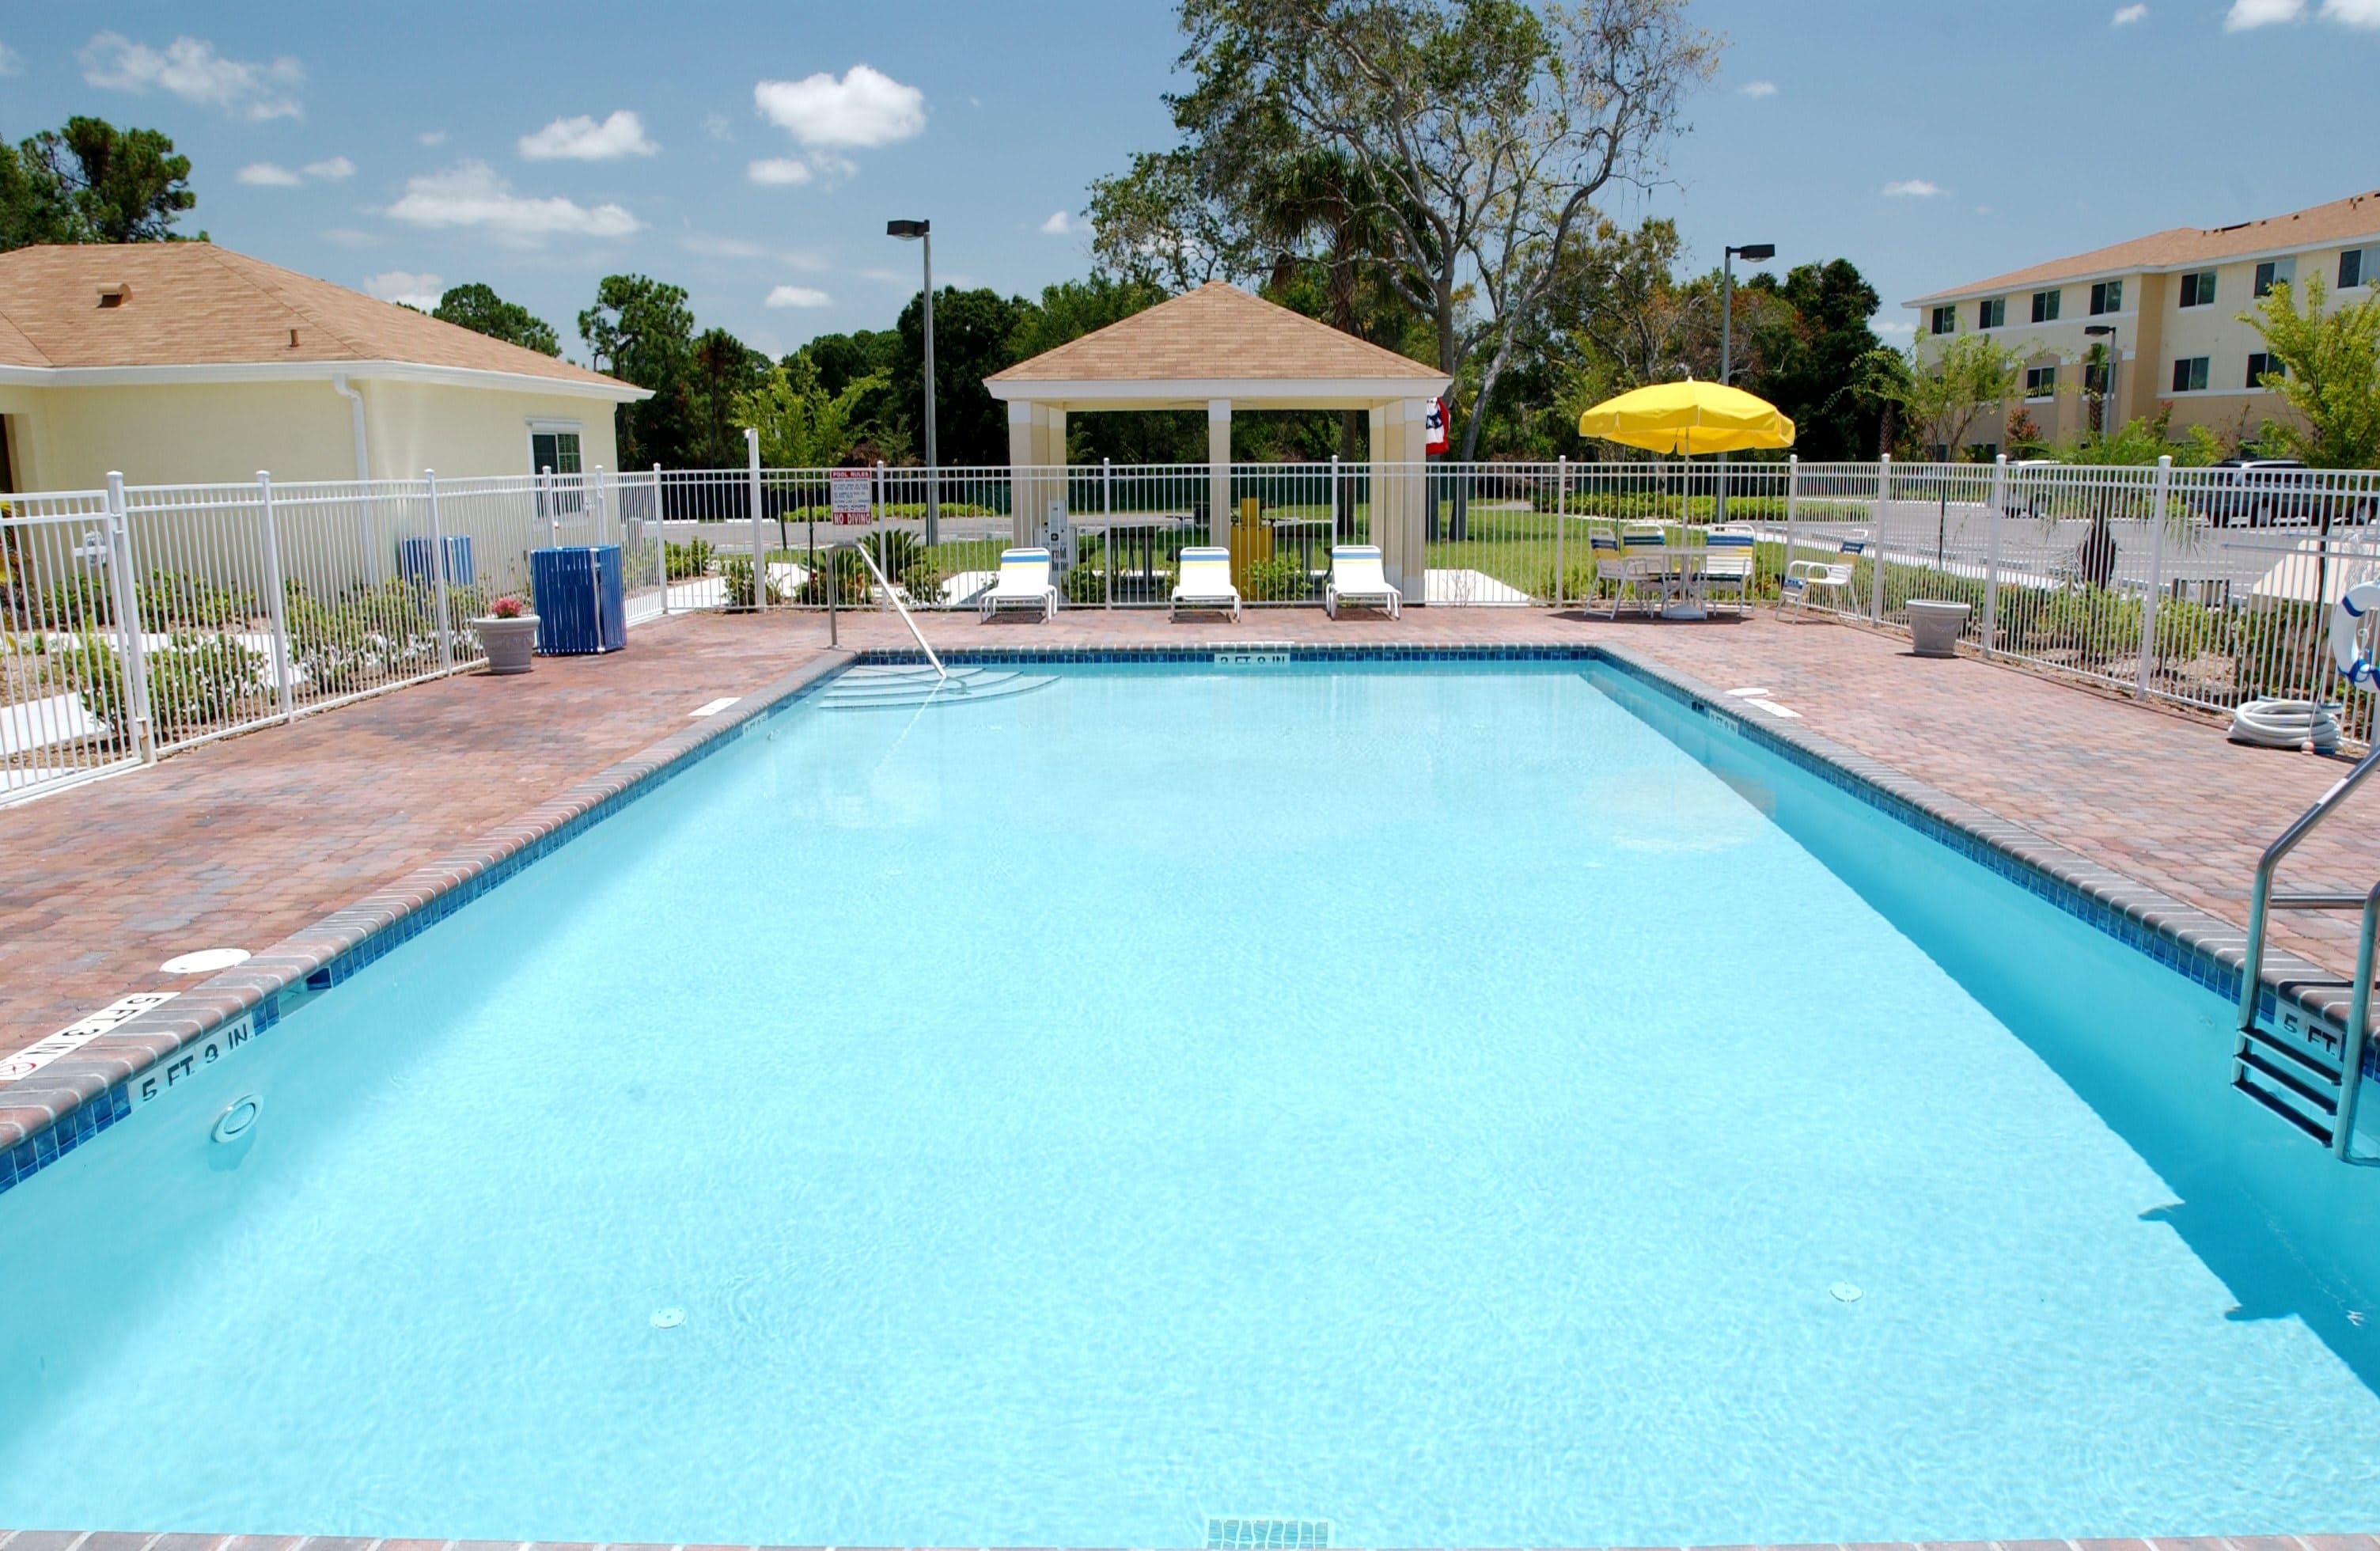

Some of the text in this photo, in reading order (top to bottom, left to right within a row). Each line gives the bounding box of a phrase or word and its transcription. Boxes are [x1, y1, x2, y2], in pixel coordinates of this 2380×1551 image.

[834, 513, 870, 524] NO DIVING
[2284, 1013, 2298, 1034] 5
[62, 1028, 100, 1037] 3
[142, 1077, 158, 1102] 5
[204, 1043, 220, 1064] 3
